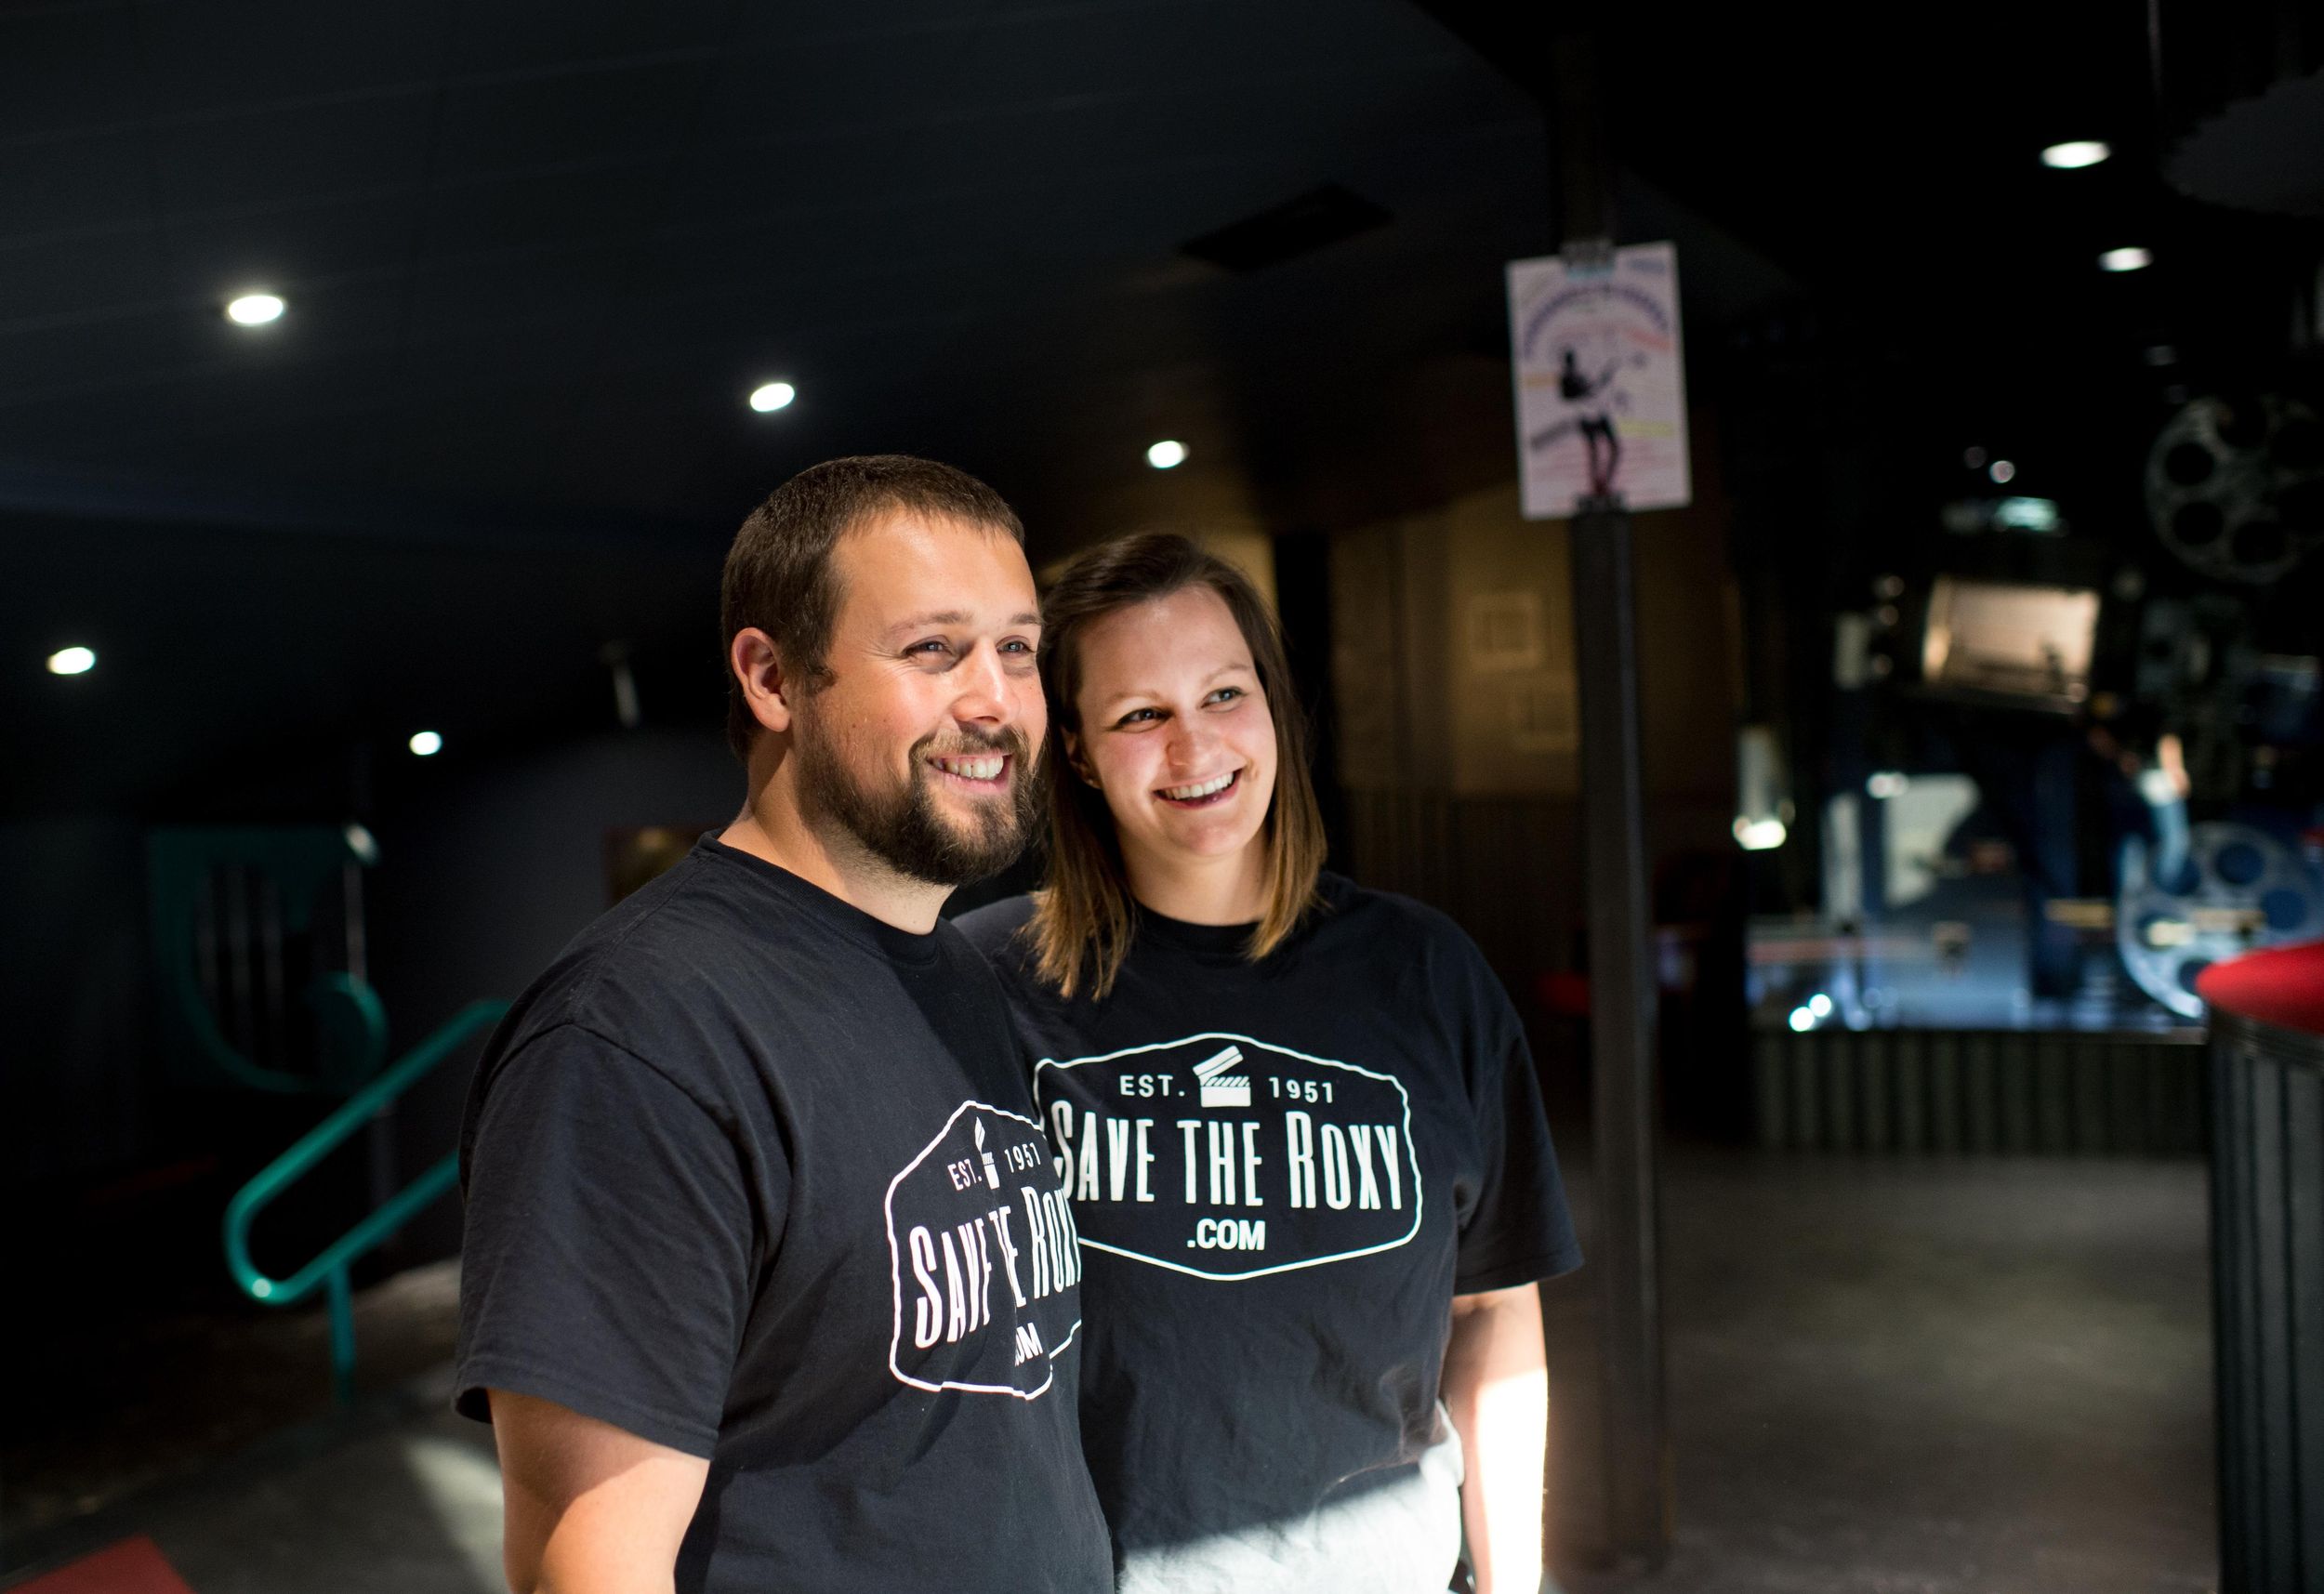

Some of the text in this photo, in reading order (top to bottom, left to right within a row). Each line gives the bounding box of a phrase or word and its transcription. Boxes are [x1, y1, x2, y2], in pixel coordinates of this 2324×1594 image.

[1120, 1074, 1334, 1104] EST. 1951
[947, 1142, 1041, 1191] EST. 1951
[1051, 1100, 1403, 1210] SAVE THE ROXY
[1187, 1219, 1266, 1250] .COM
